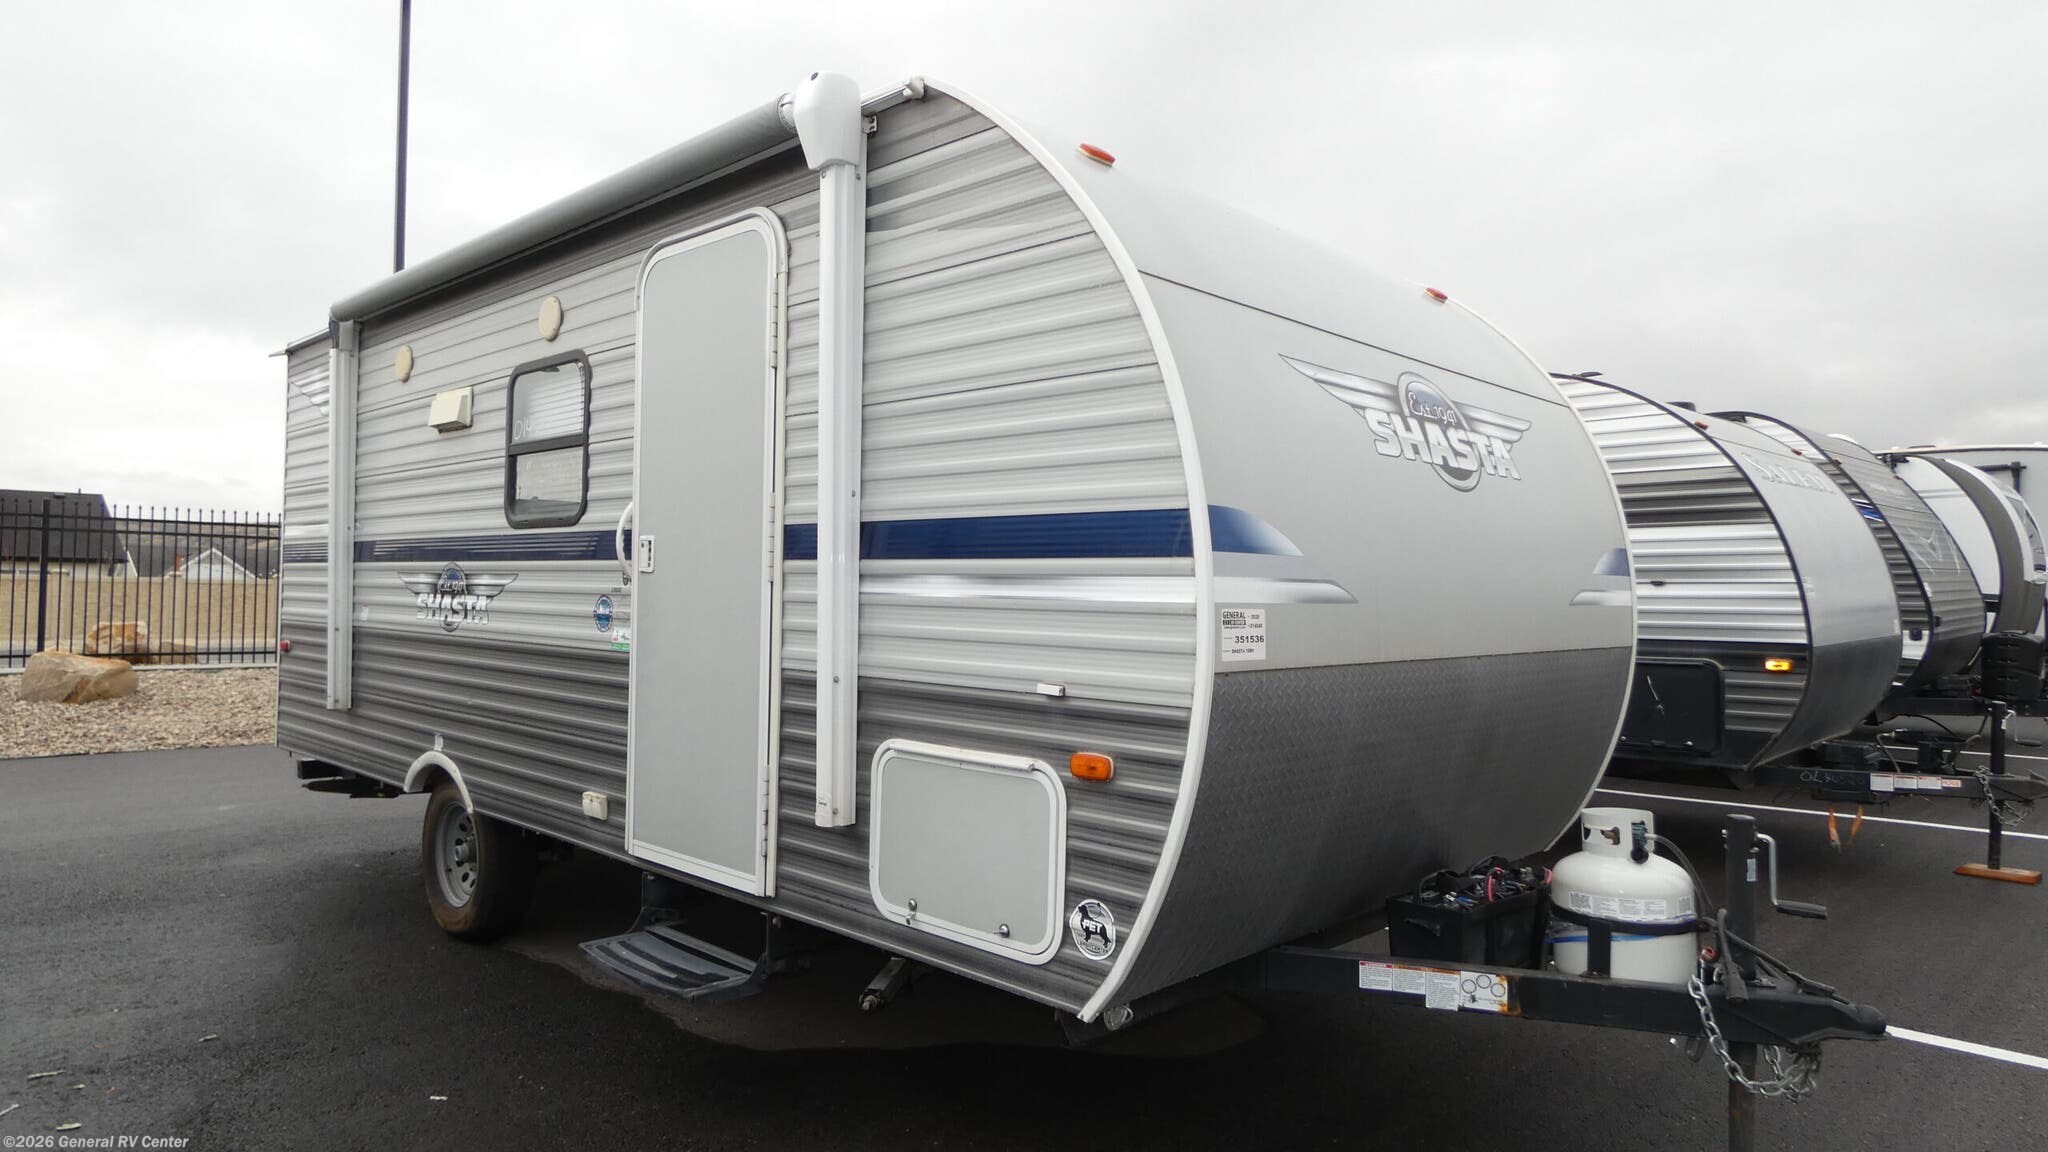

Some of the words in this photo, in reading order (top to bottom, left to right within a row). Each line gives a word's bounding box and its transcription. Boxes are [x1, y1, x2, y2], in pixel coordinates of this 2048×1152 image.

[1364, 409, 1521, 480] SHASTA
[416, 593, 489, 625] SHASTA
[1223, 611, 1246, 619] GENERAL
[1234, 635, 1264, 643] 351536
[1081, 919, 1102, 933] PET
